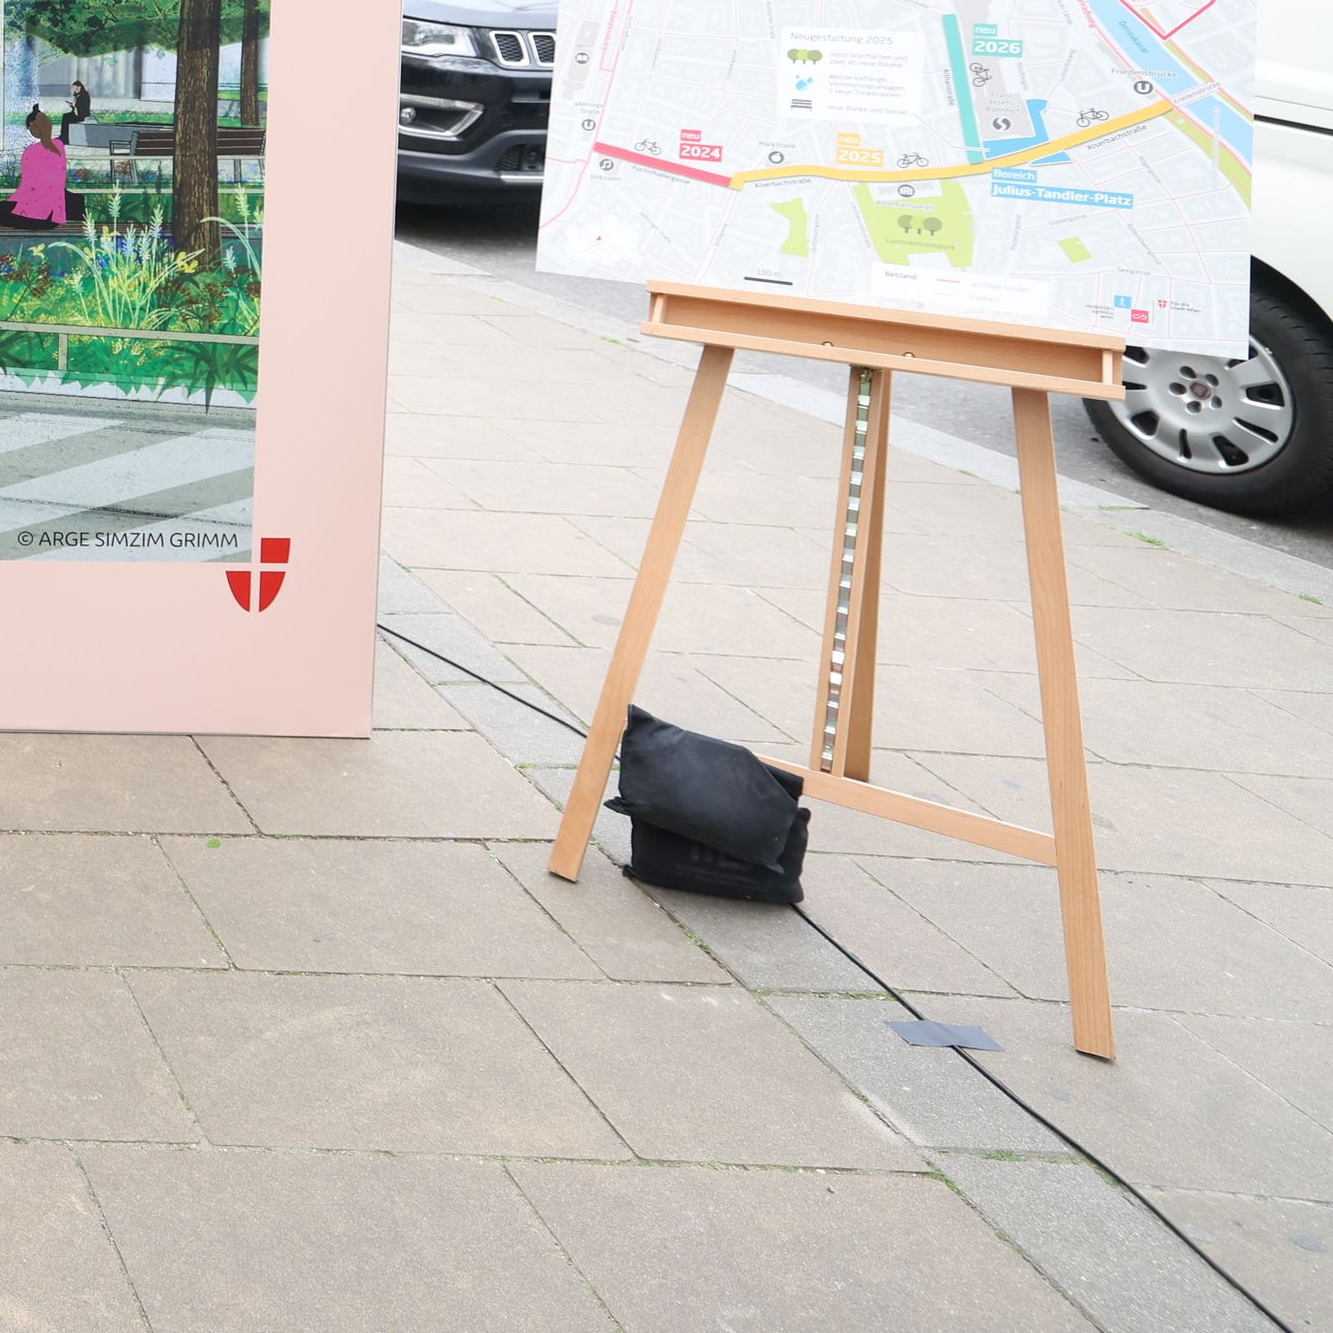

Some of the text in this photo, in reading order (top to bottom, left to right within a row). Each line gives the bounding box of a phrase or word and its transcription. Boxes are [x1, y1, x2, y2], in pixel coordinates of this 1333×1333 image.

[975, 26, 996, 35] neu
[791, 32, 893, 44] Neugestaltung 2025
[974, 40, 1021, 54] 2026
[1111, 67, 1177, 78] Friedensbrücke
[682, 132, 700, 140] neu
[839, 136, 859, 145] neu
[1087, 124, 1148, 151] Alserbachstraße
[681, 145, 721, 158] 2024
[838, 151, 881, 163] 2025
[994, 169, 1035, 180] Bereich
[754, 177, 812, 189] Alserbachstraße
[992, 185, 1132, 206] Julius-Tandler-Platz
[756, 268, 773, 276] 100
[885, 270, 917, 280] Bestand
[38, 531, 90, 547] ARGE
[94, 531, 164, 548] SIMZIM
[170, 532, 238, 548] GRIMM
